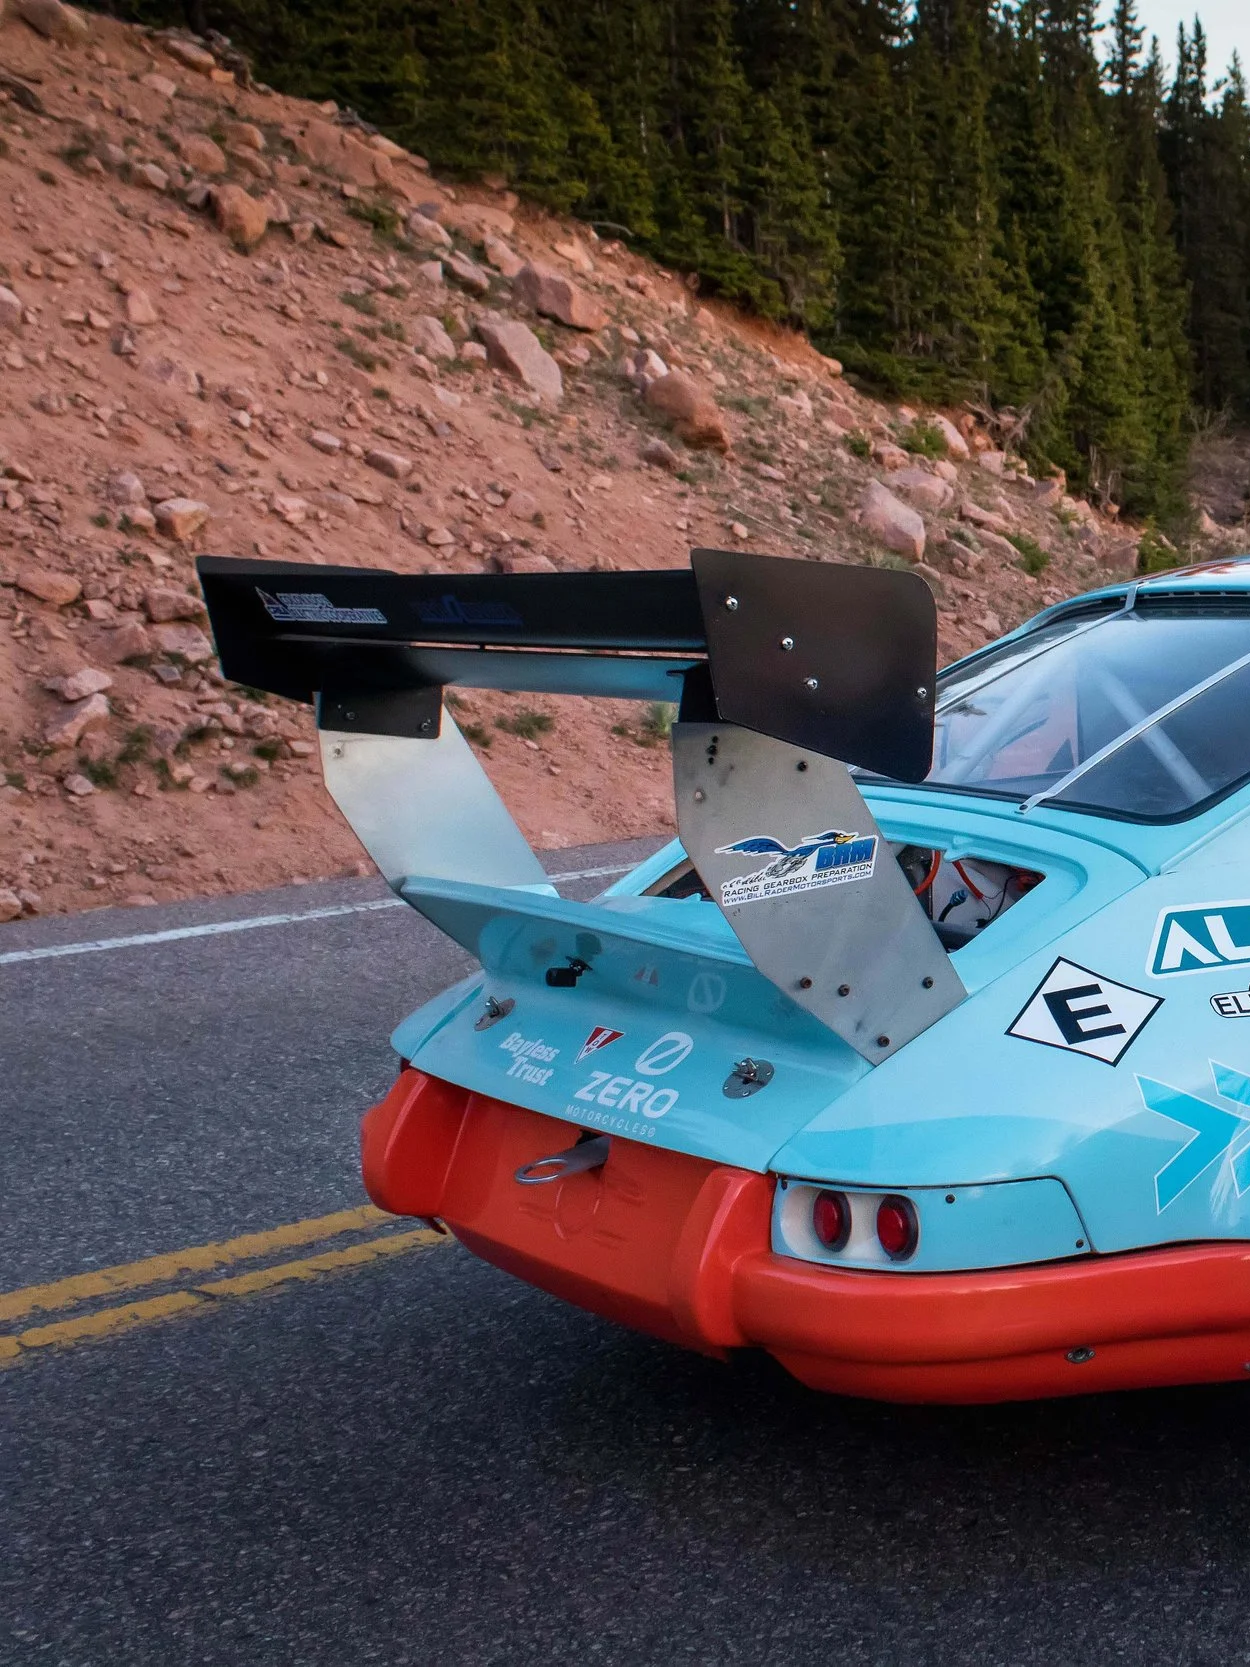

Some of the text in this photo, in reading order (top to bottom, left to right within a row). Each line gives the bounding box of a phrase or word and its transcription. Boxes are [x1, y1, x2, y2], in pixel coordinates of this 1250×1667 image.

[815, 837, 875, 872] BRM
[723, 885, 760, 898] RACING
[763, 875, 808, 890] GEARBOX
[811, 862, 873, 881] PREPARATION
[1042, 984, 1126, 1045] E
[499, 1032, 561, 1062] Bayless
[506, 1056, 555, 1087] Trust
[574, 1071, 680, 1119] ZERO
